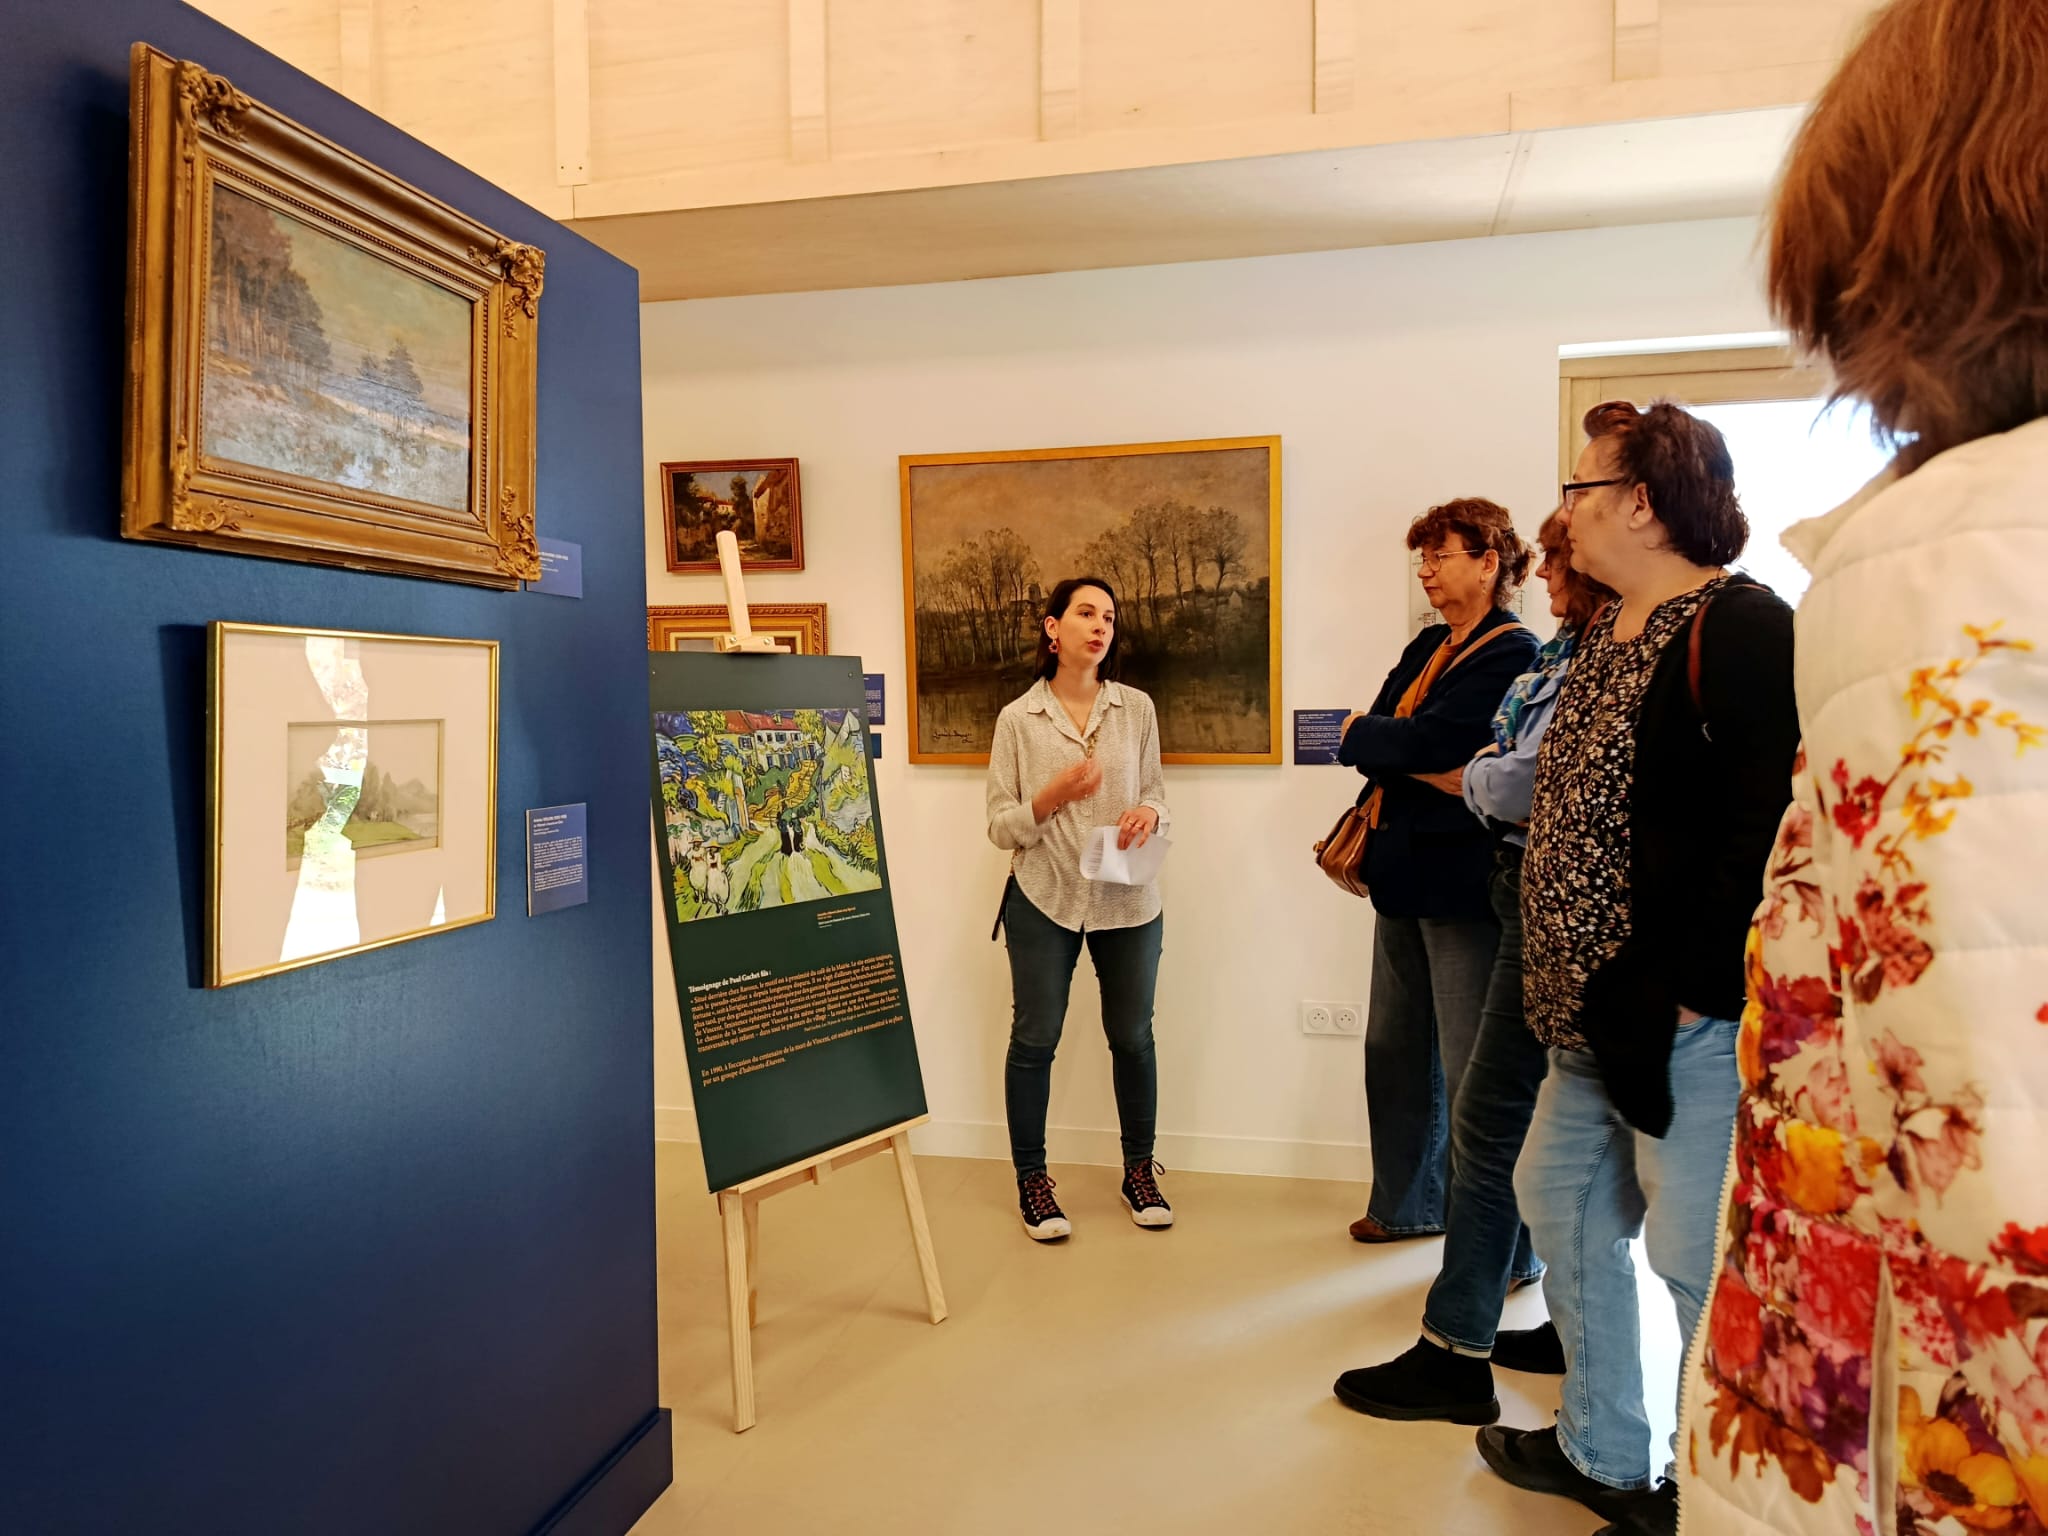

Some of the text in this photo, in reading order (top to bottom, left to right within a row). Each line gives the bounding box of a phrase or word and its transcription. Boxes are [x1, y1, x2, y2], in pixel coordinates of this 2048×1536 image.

[687, 981, 721, 993] Témoignage
[728, 975, 741, 984] Paul
[741, 970, 760, 981] Gachet
[760, 969, 768, 977] fils
[704, 1032, 723, 1042] chemin
